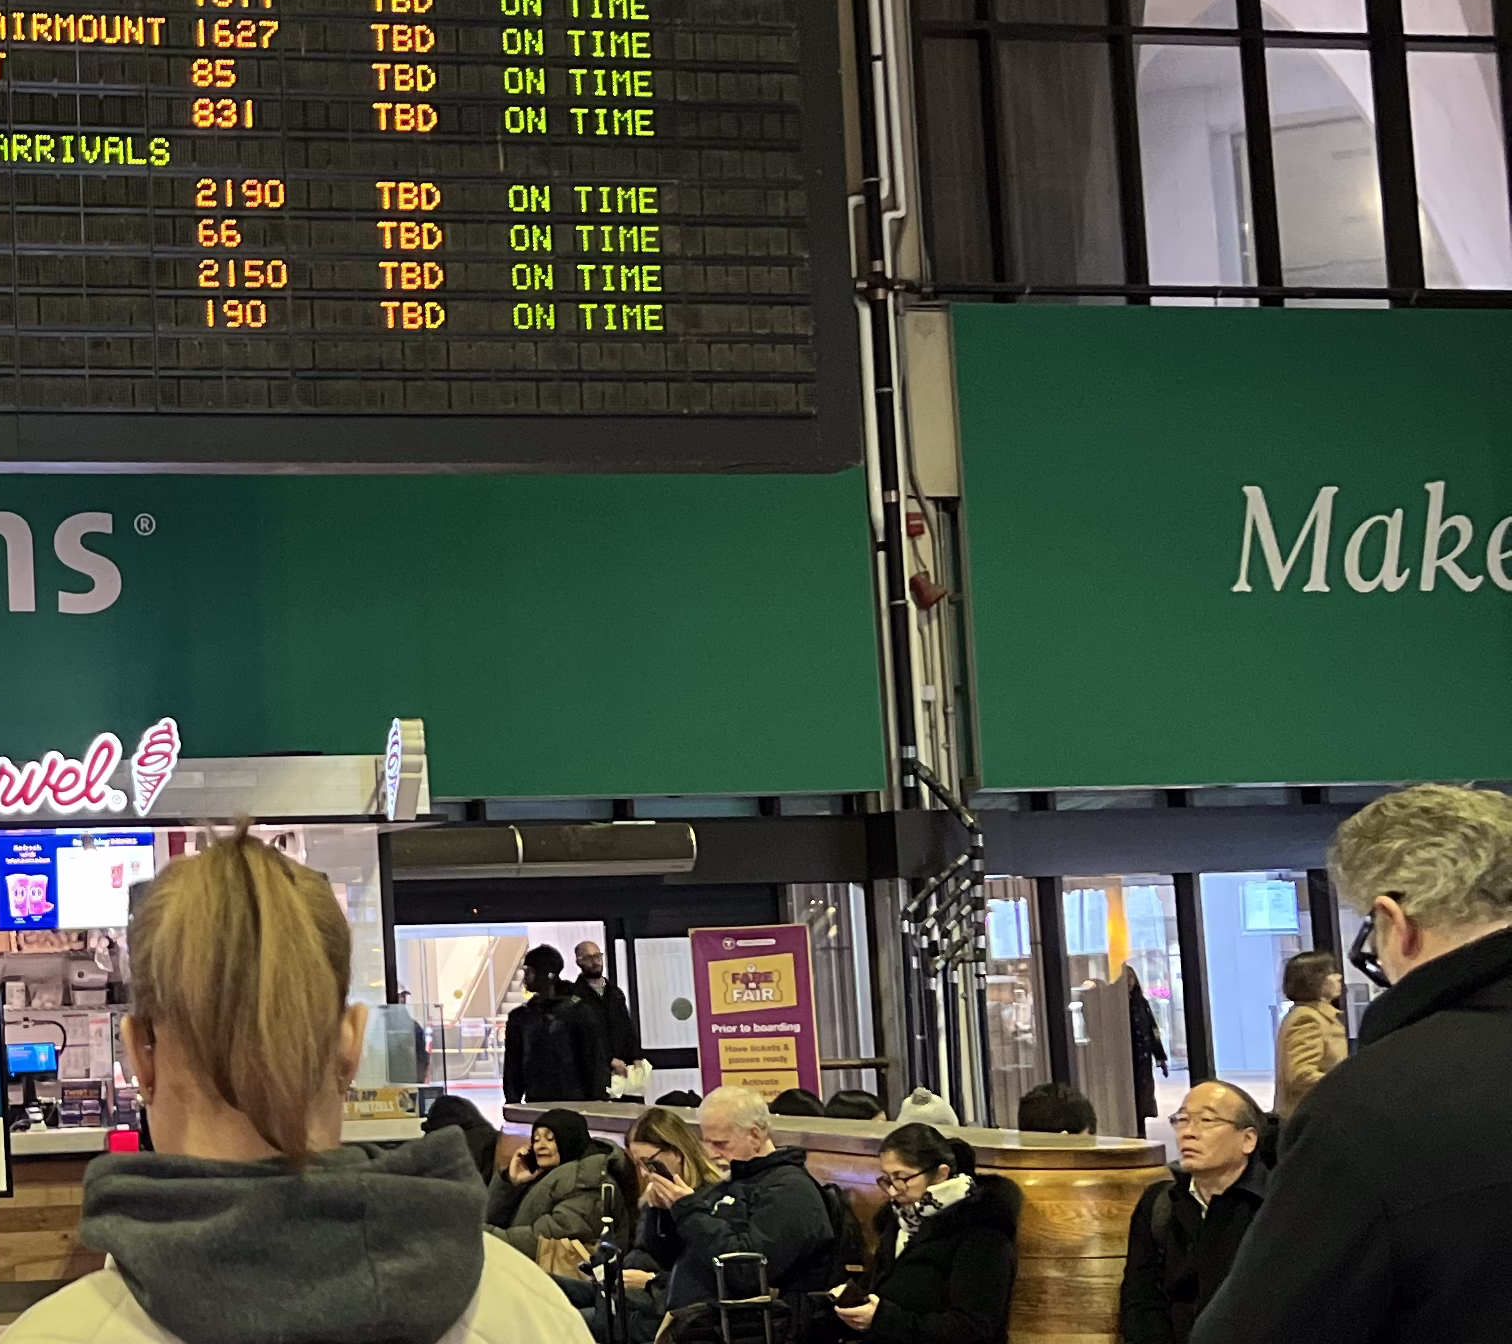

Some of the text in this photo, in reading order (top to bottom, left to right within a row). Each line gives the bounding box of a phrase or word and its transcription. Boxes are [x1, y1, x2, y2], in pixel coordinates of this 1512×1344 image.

[197, 219, 243, 249] 66
[377, 222, 444, 251] TBD
[510, 225, 553, 253] ON
[575, 226, 661, 254] TIME
[732, 988, 775, 1002] FAIR
[711, 1022, 801, 1034] Prior to boarding
